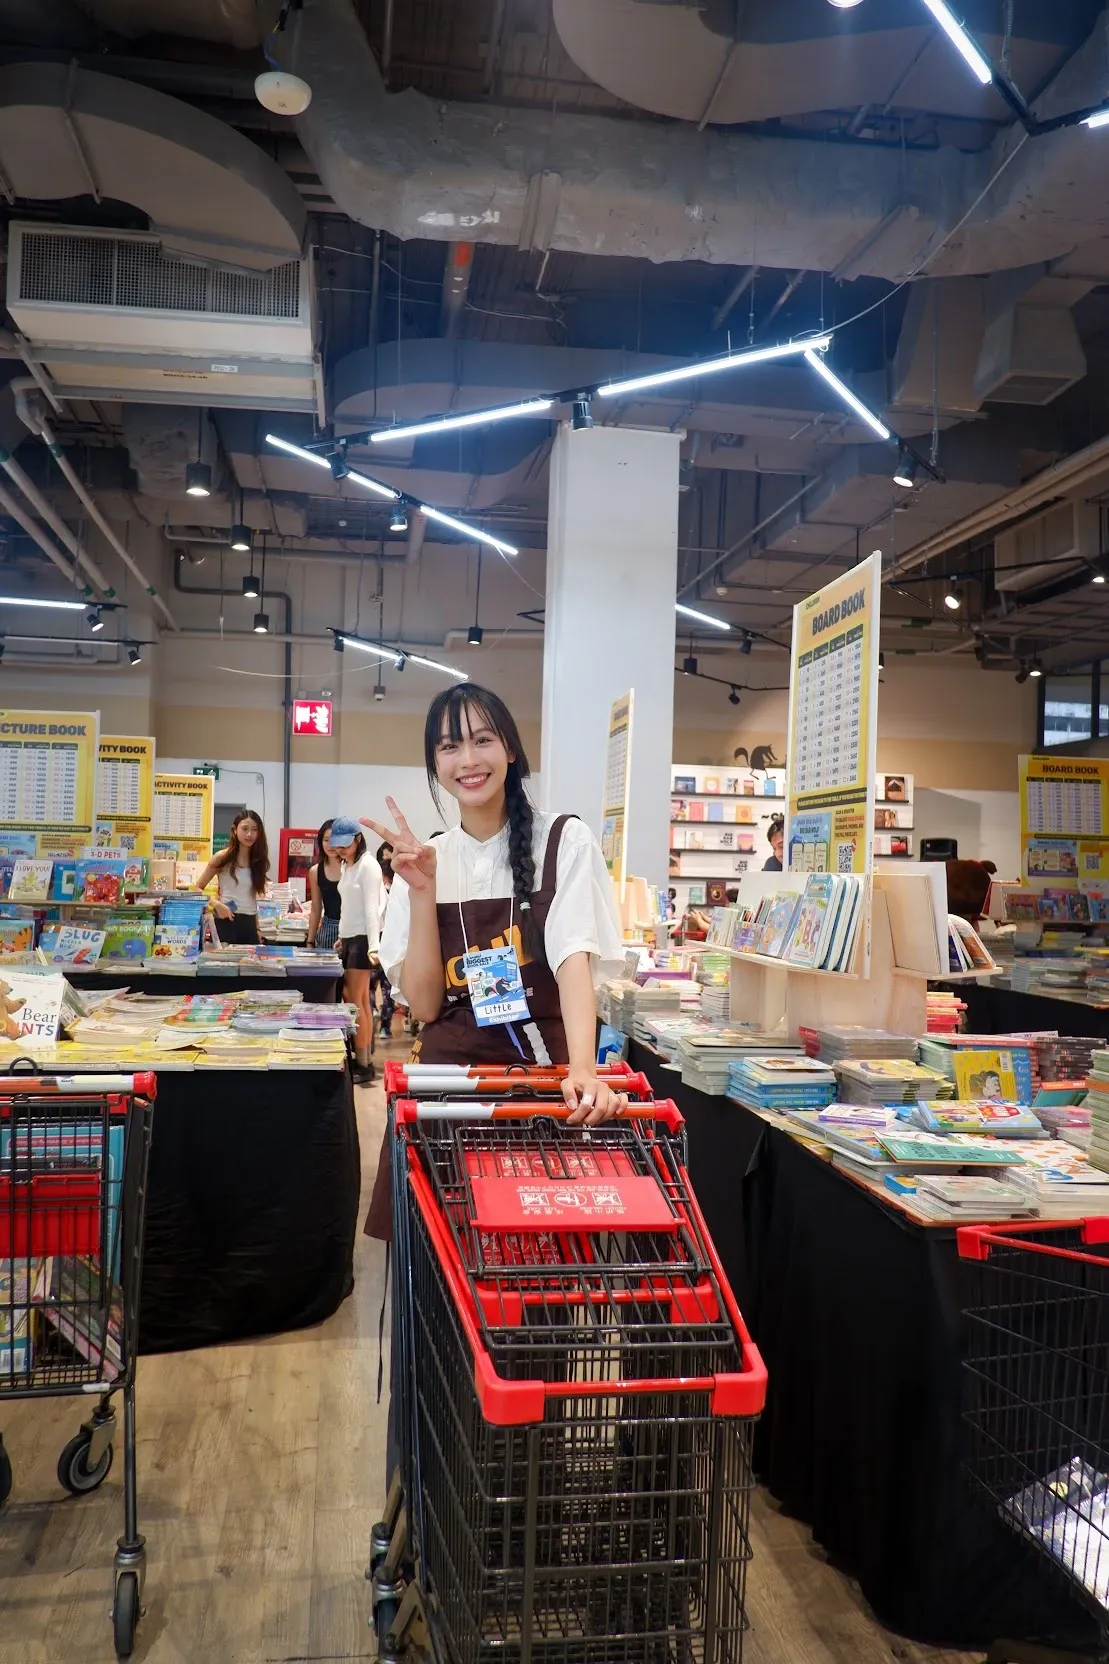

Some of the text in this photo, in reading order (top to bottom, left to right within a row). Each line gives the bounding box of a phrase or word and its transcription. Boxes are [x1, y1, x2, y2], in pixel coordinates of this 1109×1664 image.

[812, 587, 866, 636] BOARD BOOK
[0, 723, 86, 736] CTURE BOOK
[119, 745, 146, 754] BOOK
[1042, 764, 1099, 775] BOARD BOOK
[104, 851, 120, 859] PETS
[64, 929, 101, 943] SLUG
[466, 956, 493, 965] BIGGEST
[21, 1007, 57, 1022] Bear
[489, 1014, 519, 1023] Exhibitor
[16, 1022, 54, 1036] NTS
